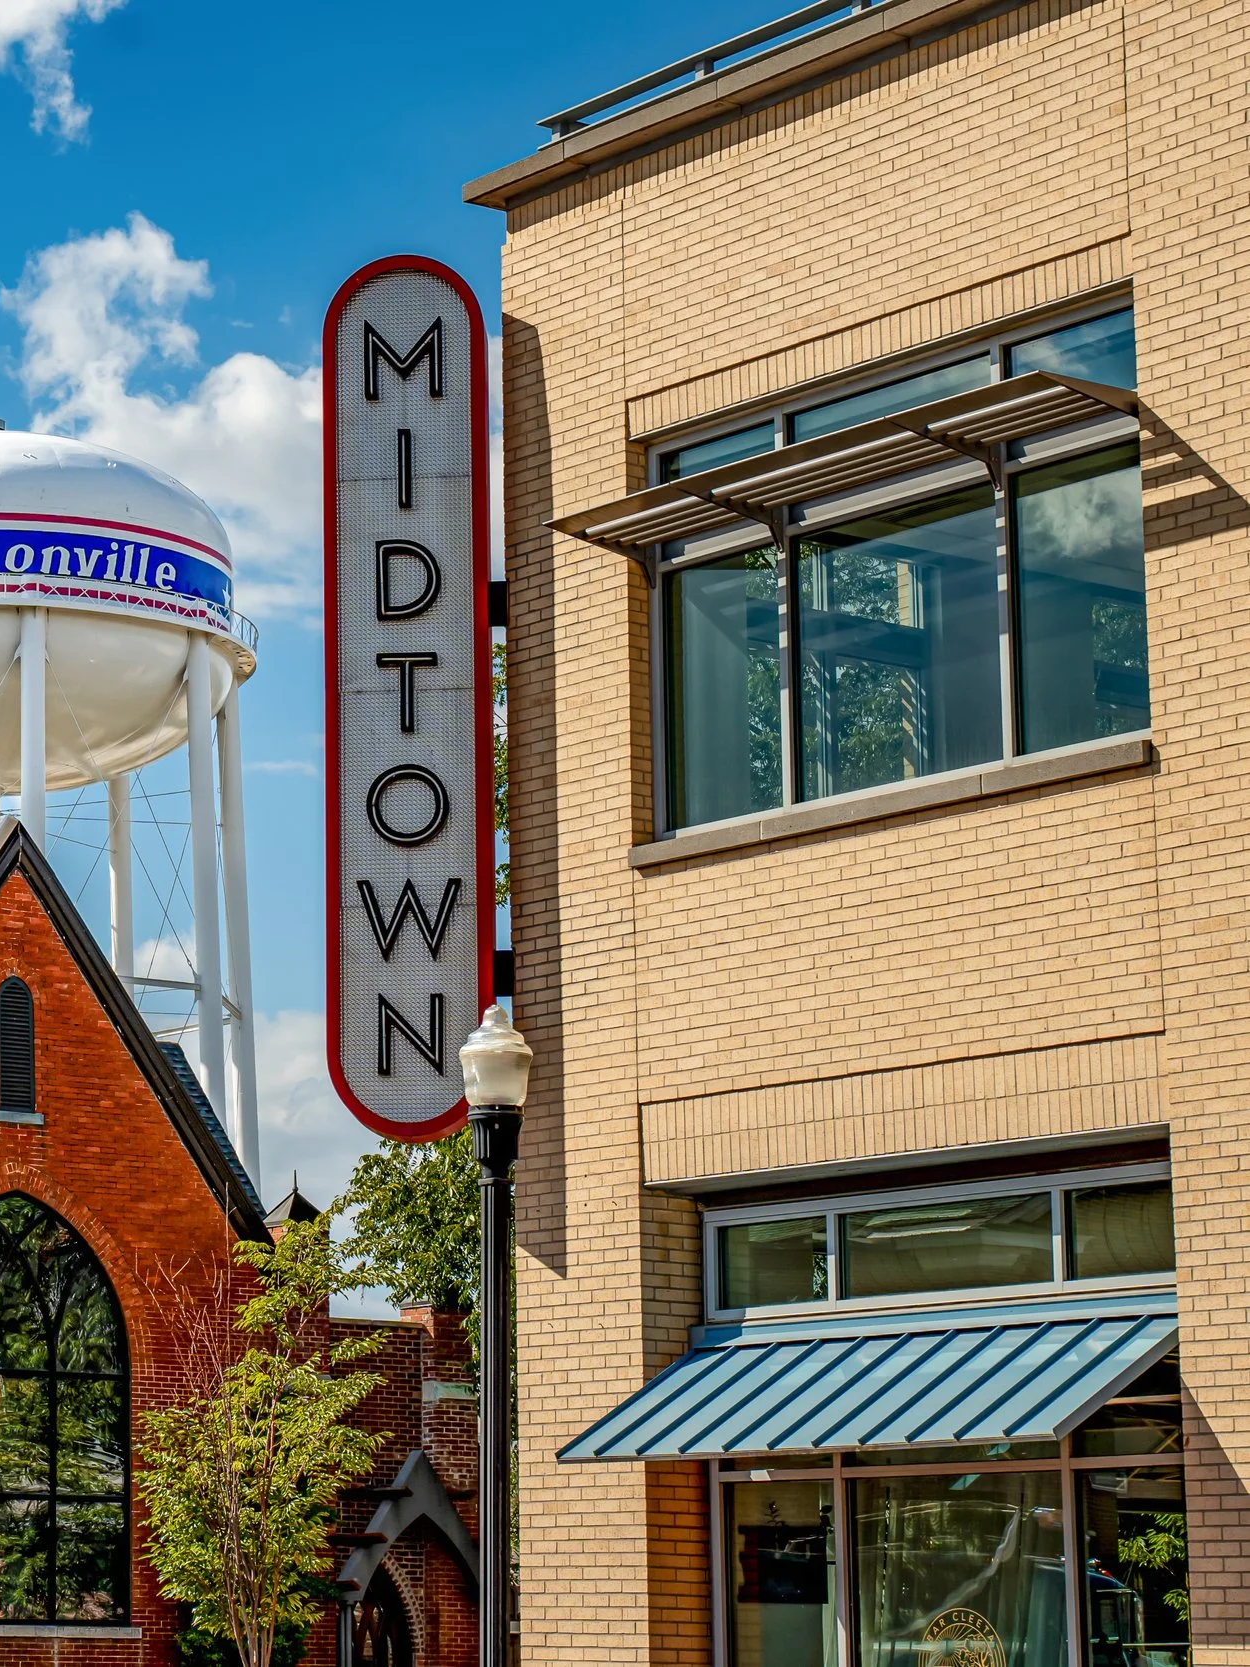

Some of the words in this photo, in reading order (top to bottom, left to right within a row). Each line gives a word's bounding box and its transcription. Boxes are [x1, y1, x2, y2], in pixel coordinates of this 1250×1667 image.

[357, 314, 461, 1078] MIDTOWN
[926, 1618, 946, 1642] BAR
[952, 1612, 995, 1643] CLEETA
